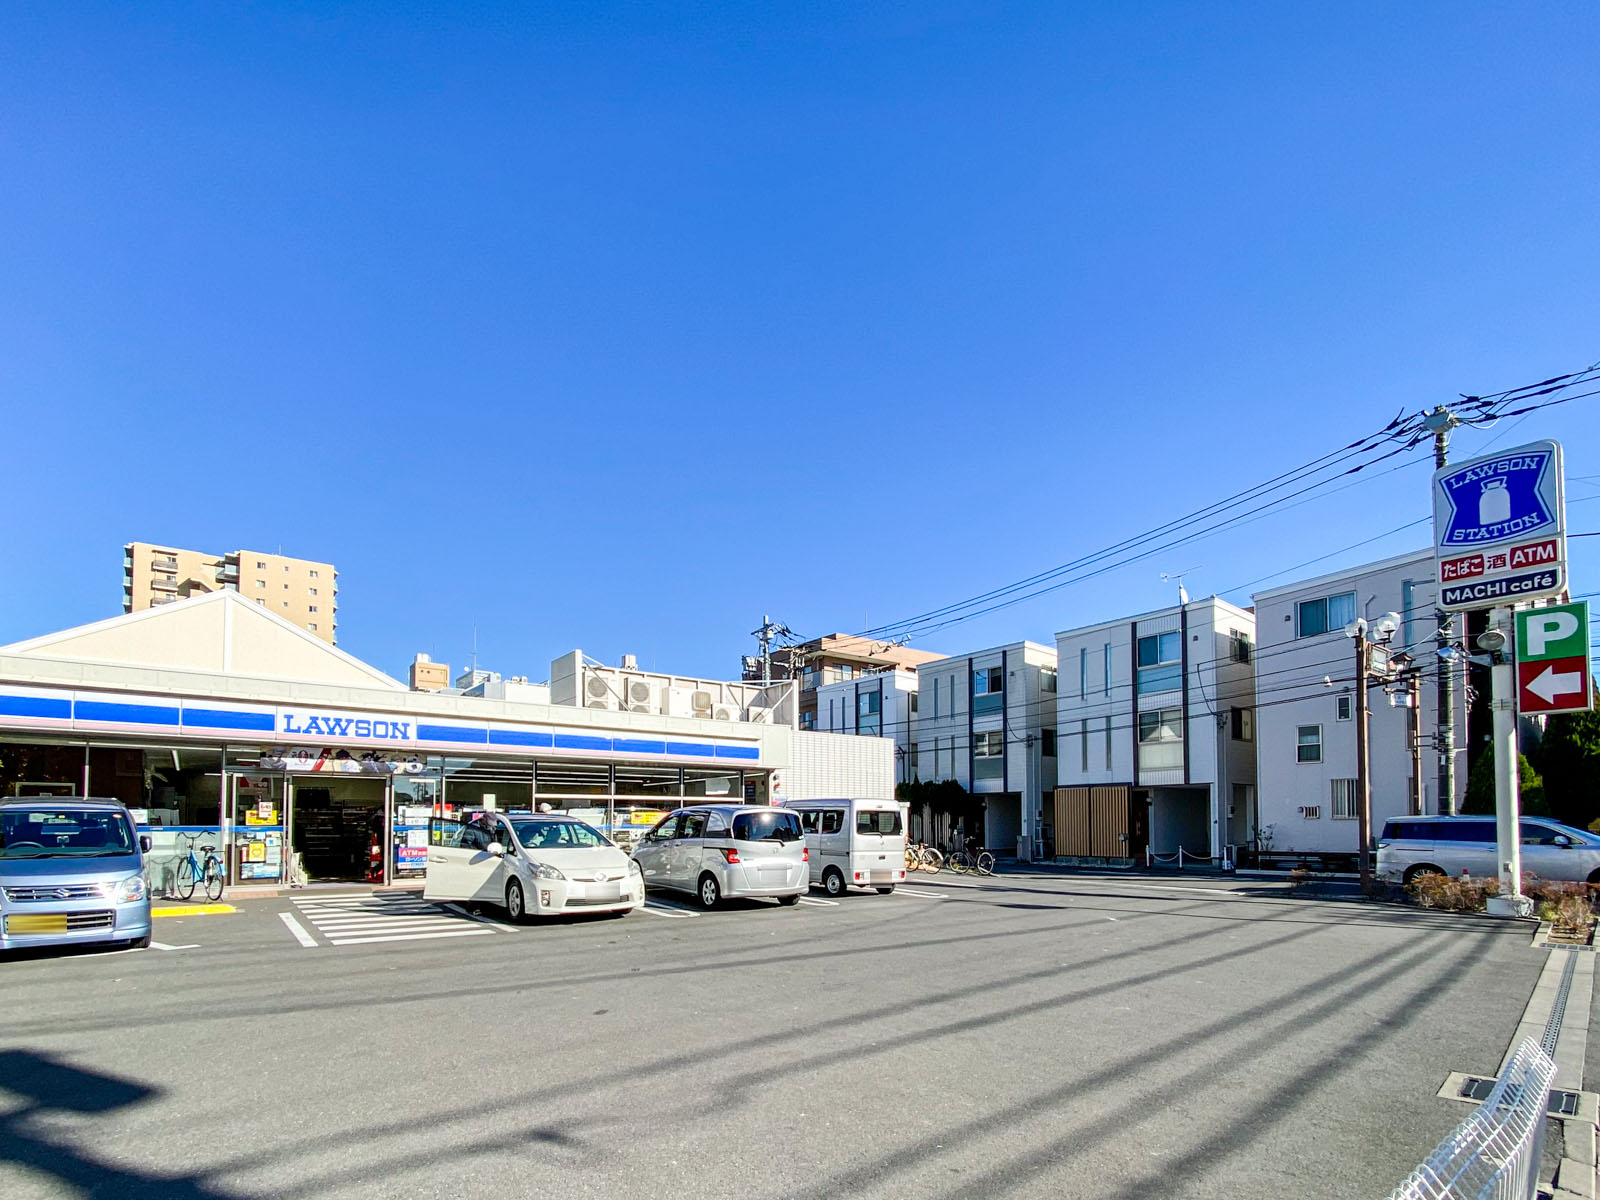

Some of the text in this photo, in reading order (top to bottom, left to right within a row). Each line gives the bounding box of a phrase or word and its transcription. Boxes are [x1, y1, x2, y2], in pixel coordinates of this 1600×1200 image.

[1450, 457, 1540, 489] LAWSON
[1453, 512, 1540, 540] STATION
[1443, 544, 1554, 578] たばこ 酒 ATM
[1446, 574, 1553, 602] MACHI café
[1526, 611, 1579, 656] P
[283, 714, 410, 740] LAWSON
